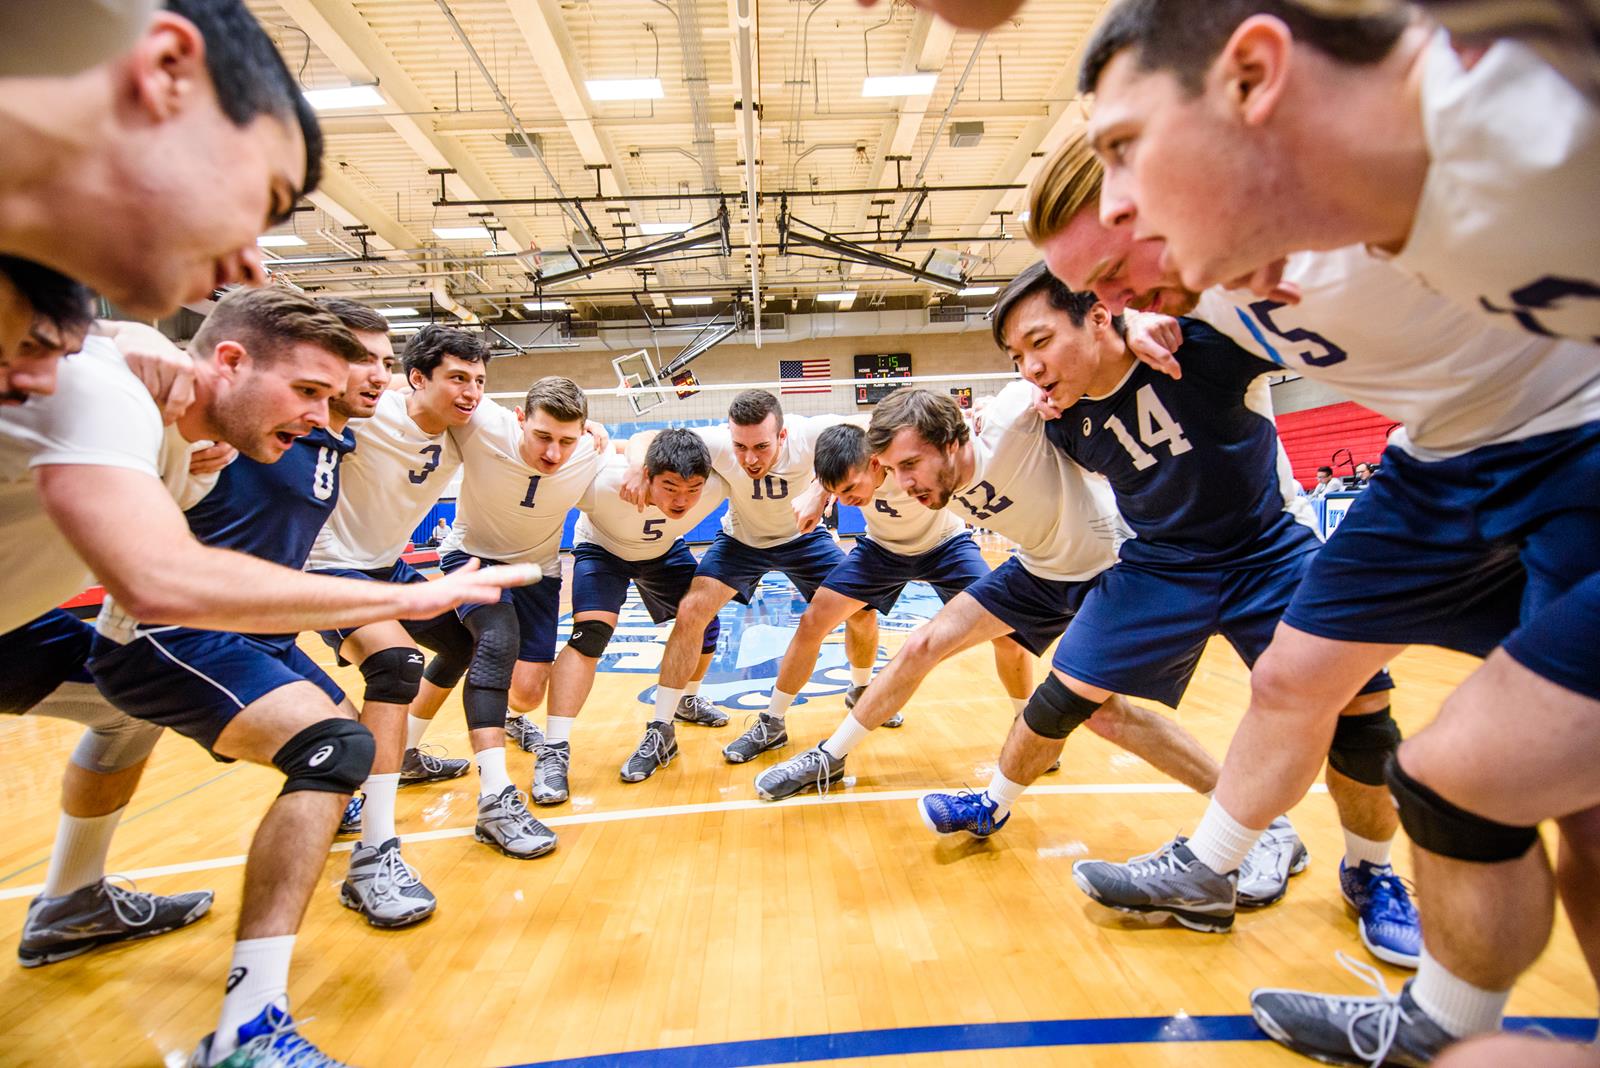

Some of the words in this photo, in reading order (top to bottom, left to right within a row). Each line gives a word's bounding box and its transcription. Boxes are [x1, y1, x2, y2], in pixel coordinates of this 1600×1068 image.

[878, 356, 899, 367] 1:15
[1103, 383, 1193, 472] 14
[312, 446, 338, 500] 8
[408, 444, 442, 484] 3
[519, 475, 541, 508] 1
[751, 475, 789, 499] 10
[952, 479, 1014, 520] 12
[874, 498, 902, 518] 4
[641, 518, 666, 541] 5
